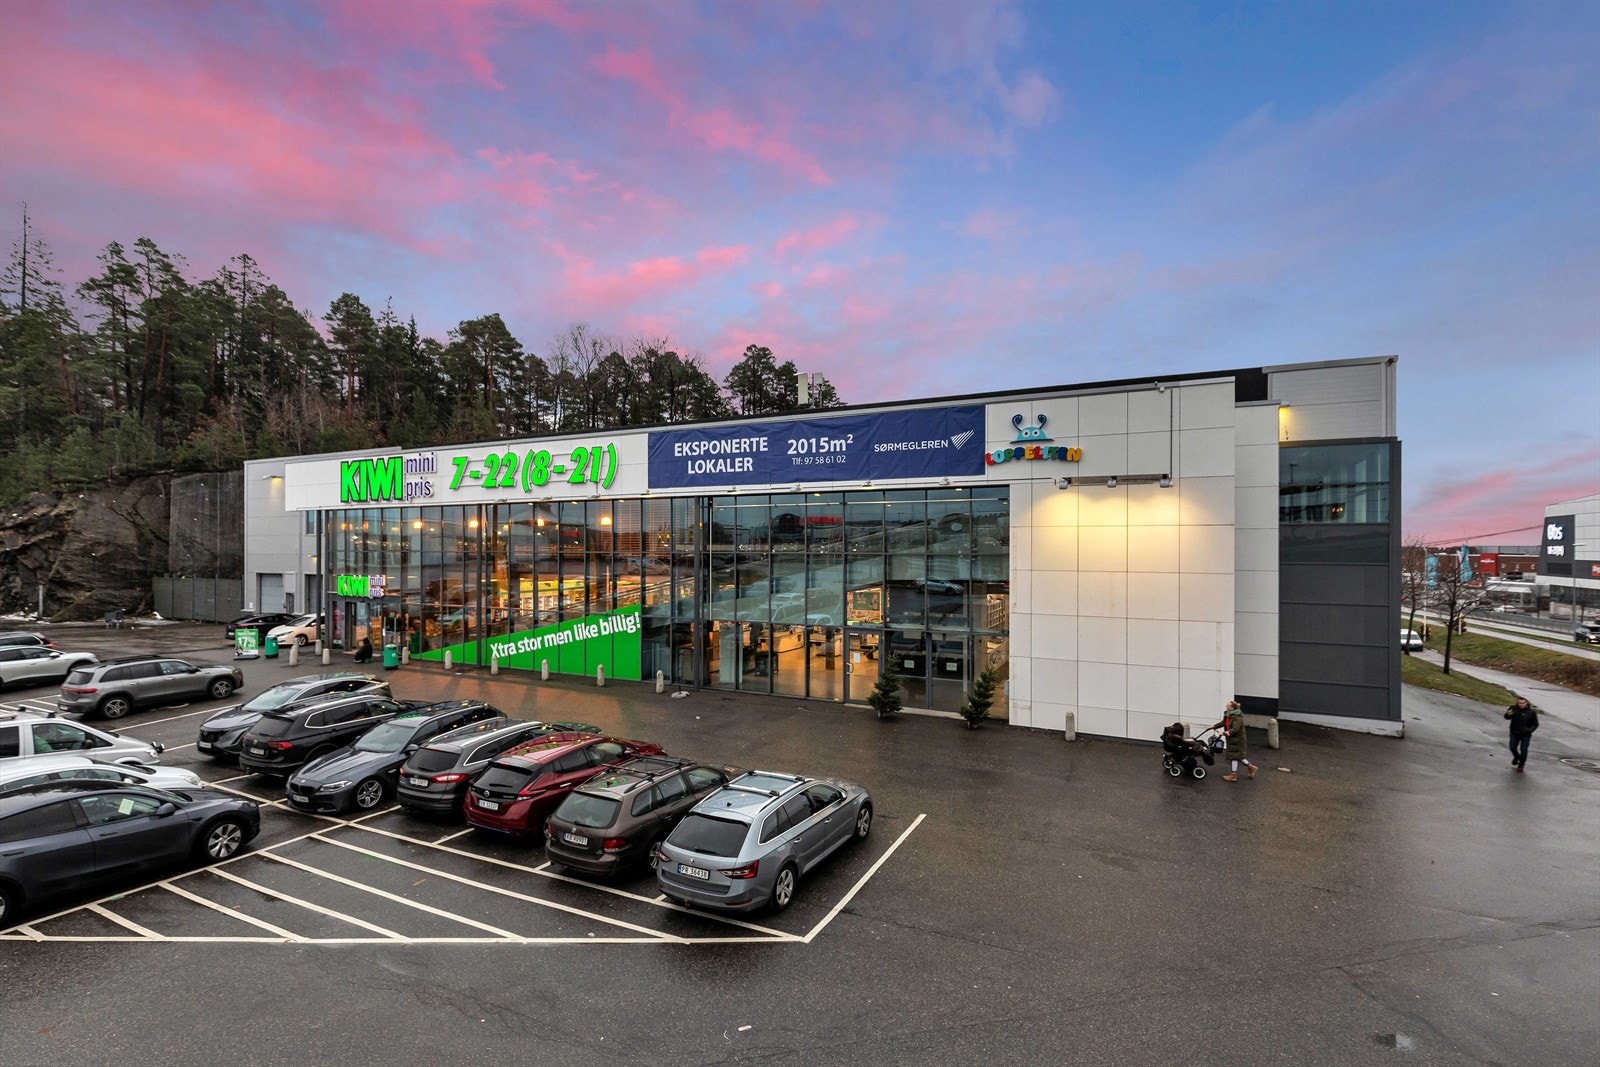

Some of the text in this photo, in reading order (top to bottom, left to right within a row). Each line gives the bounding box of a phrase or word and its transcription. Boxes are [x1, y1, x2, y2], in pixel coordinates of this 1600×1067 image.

[674, 437, 769, 457] EKSPONERTE
[873, 439, 949, 453] SØRMEGLEREN
[984, 445, 1082, 466] LOPPELITEN
[406, 451, 435, 474] mini
[687, 457, 754, 475] LOKALER
[791, 455, 847, 466] Tlf: 97 58 61 02
[340, 456, 404, 503] KIWI
[406, 475, 432, 502] pris
[337, 574, 369, 598] KIWI
[369, 575, 386, 587] mini
[369, 586, 385, 600] pris
[490, 611, 642, 659] Xtra stor men like billig!
